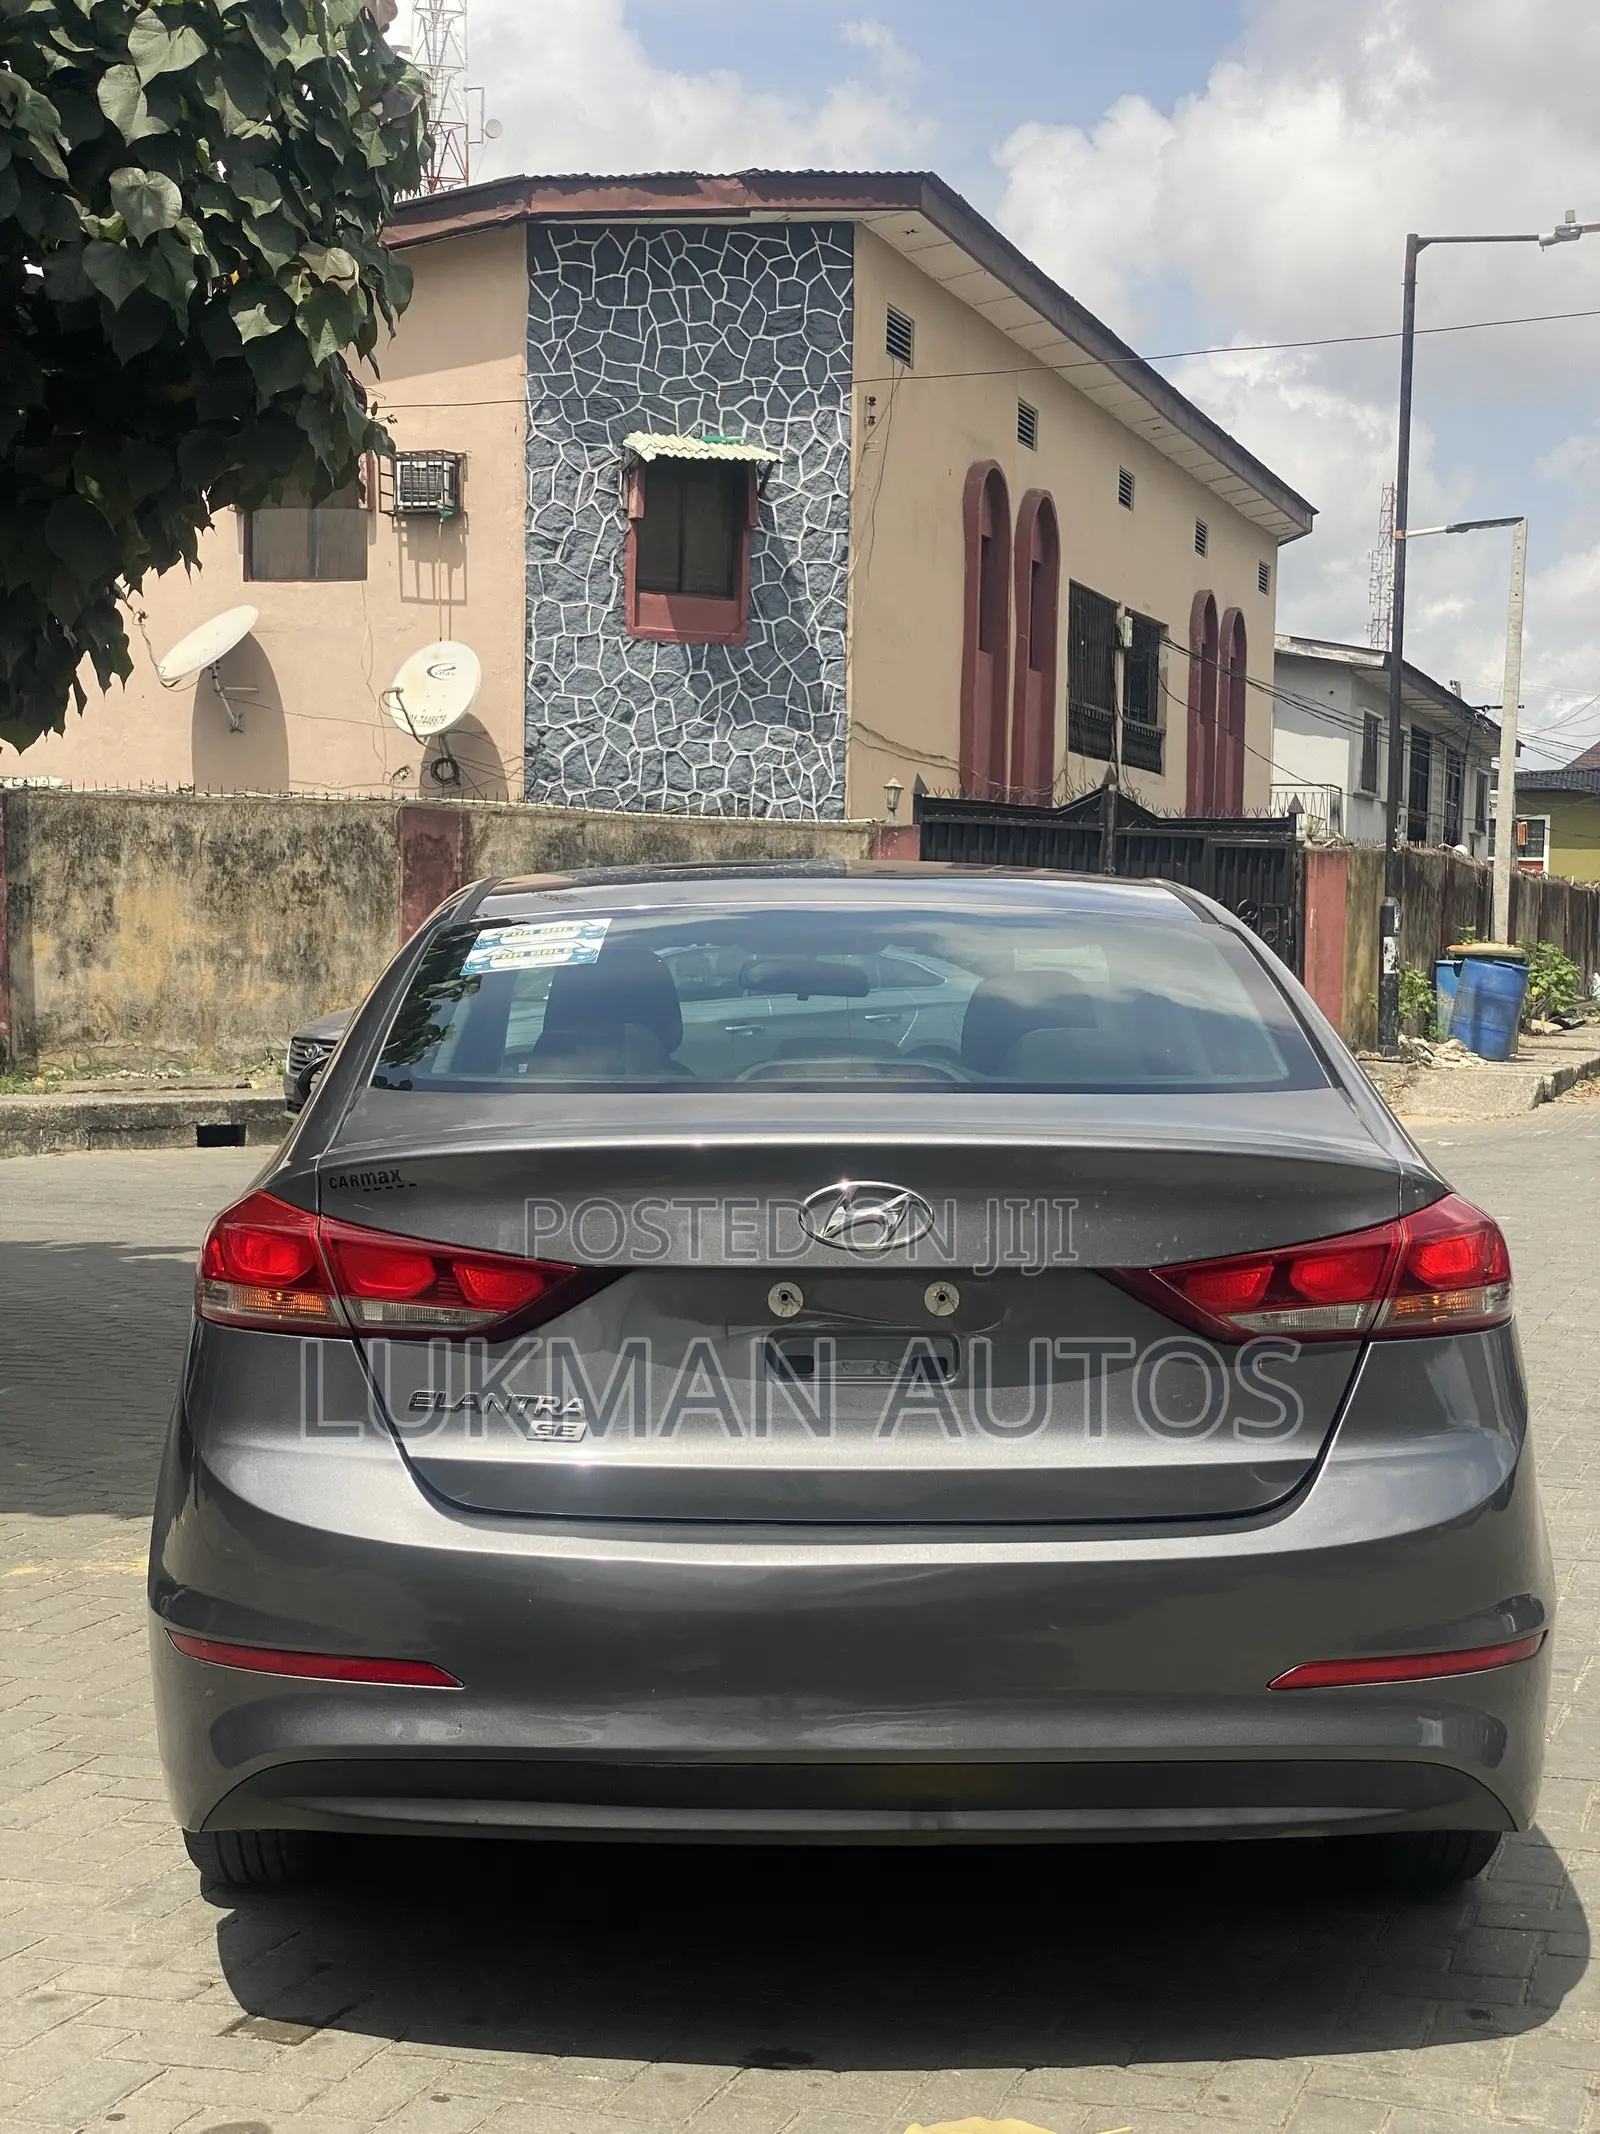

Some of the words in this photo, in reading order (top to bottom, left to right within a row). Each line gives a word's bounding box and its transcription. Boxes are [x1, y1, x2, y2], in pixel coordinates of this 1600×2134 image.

[502, 929, 533, 938] FOR
[491, 950, 525, 961] FOR
[530, 947, 574, 957] SALE
[408, 1390, 587, 1417] ELANTRA
[532, 1423, 580, 1438] SE
